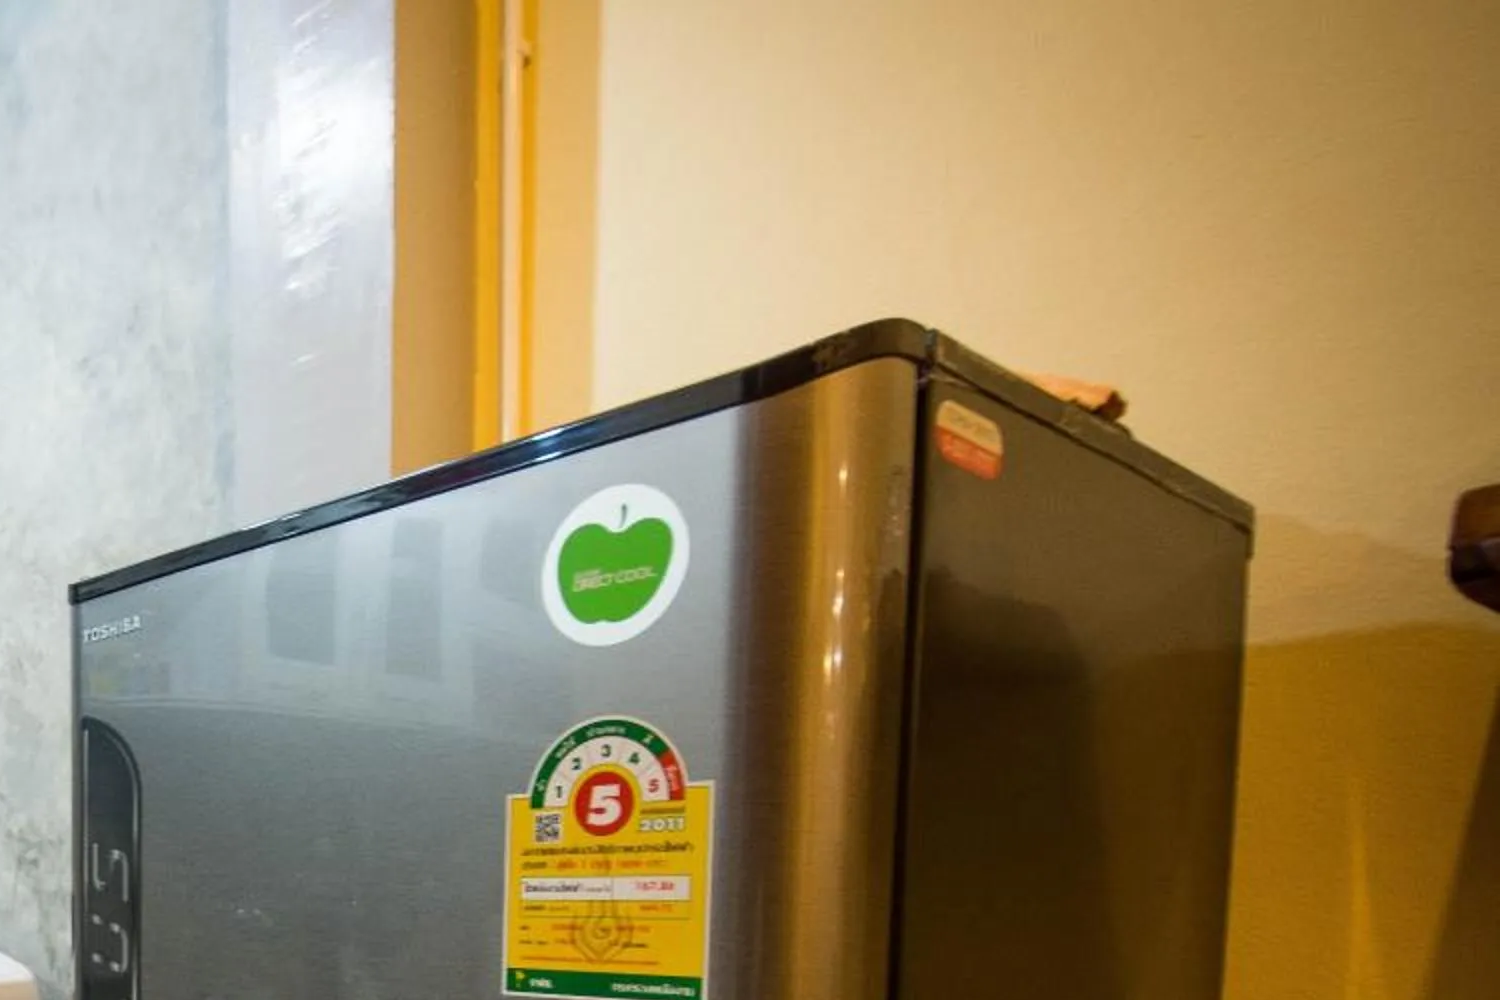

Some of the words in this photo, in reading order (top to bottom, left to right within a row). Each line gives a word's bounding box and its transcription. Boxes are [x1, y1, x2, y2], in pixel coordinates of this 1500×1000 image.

[556, 785, 563, 798] 1
[572, 757, 581, 770] 2
[601, 744, 611, 757] 3
[627, 752, 640, 764] 4
[648, 778, 660, 793] 5
[586, 783, 623, 827] 5
